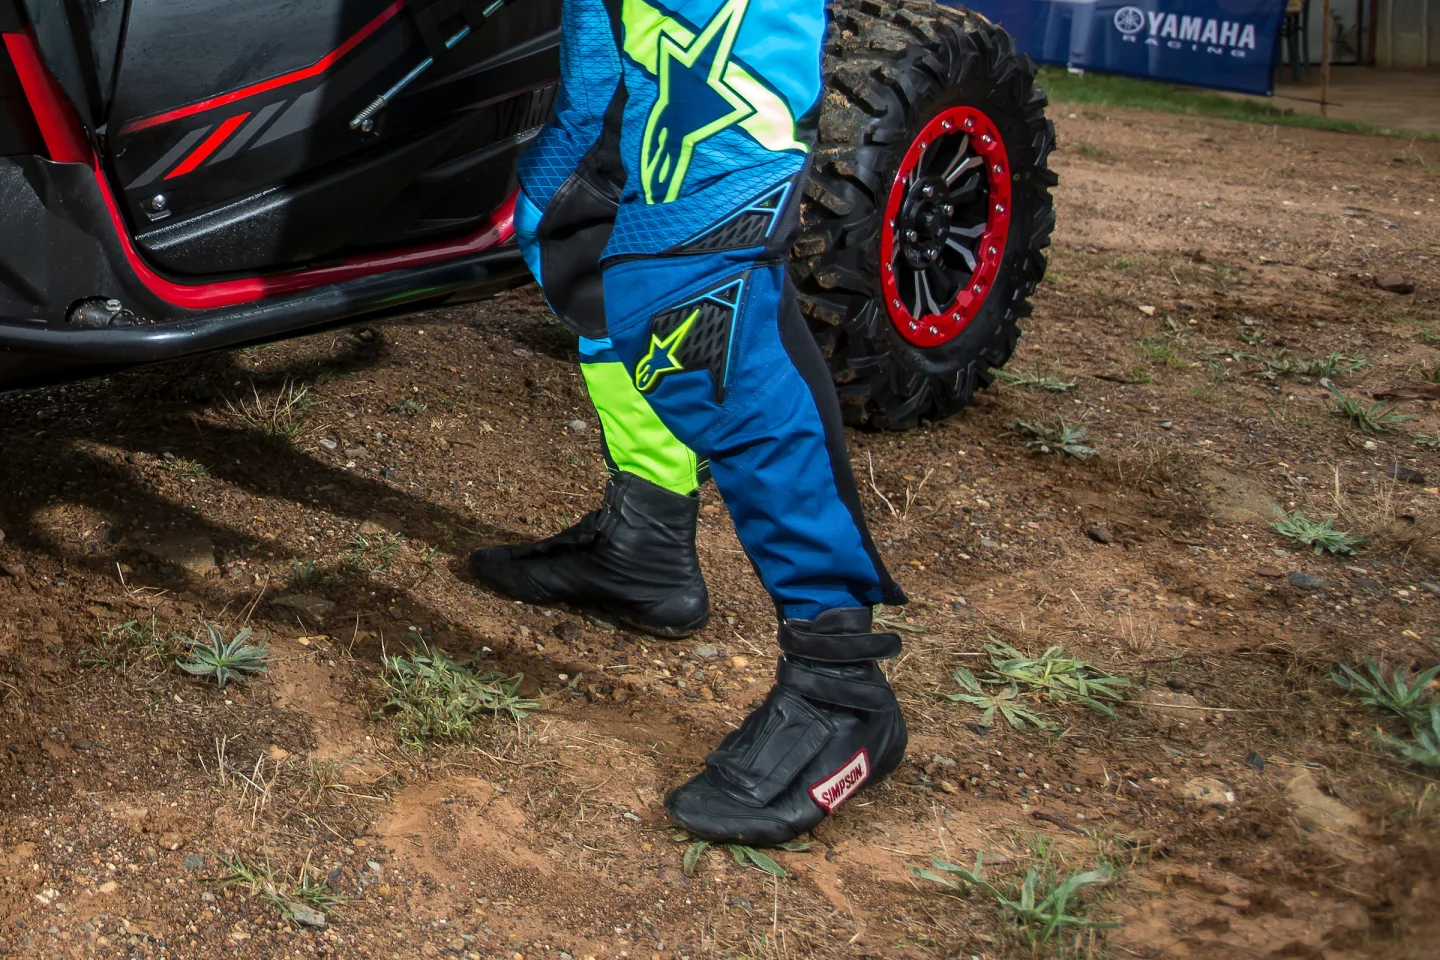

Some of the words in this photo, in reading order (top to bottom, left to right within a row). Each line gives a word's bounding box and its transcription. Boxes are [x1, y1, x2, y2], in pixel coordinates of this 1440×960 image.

[1122, 34, 1247, 58] RACING
[1147, 11, 1257, 50] YAMAHA
[821, 763, 863, 806] SIMPSON
